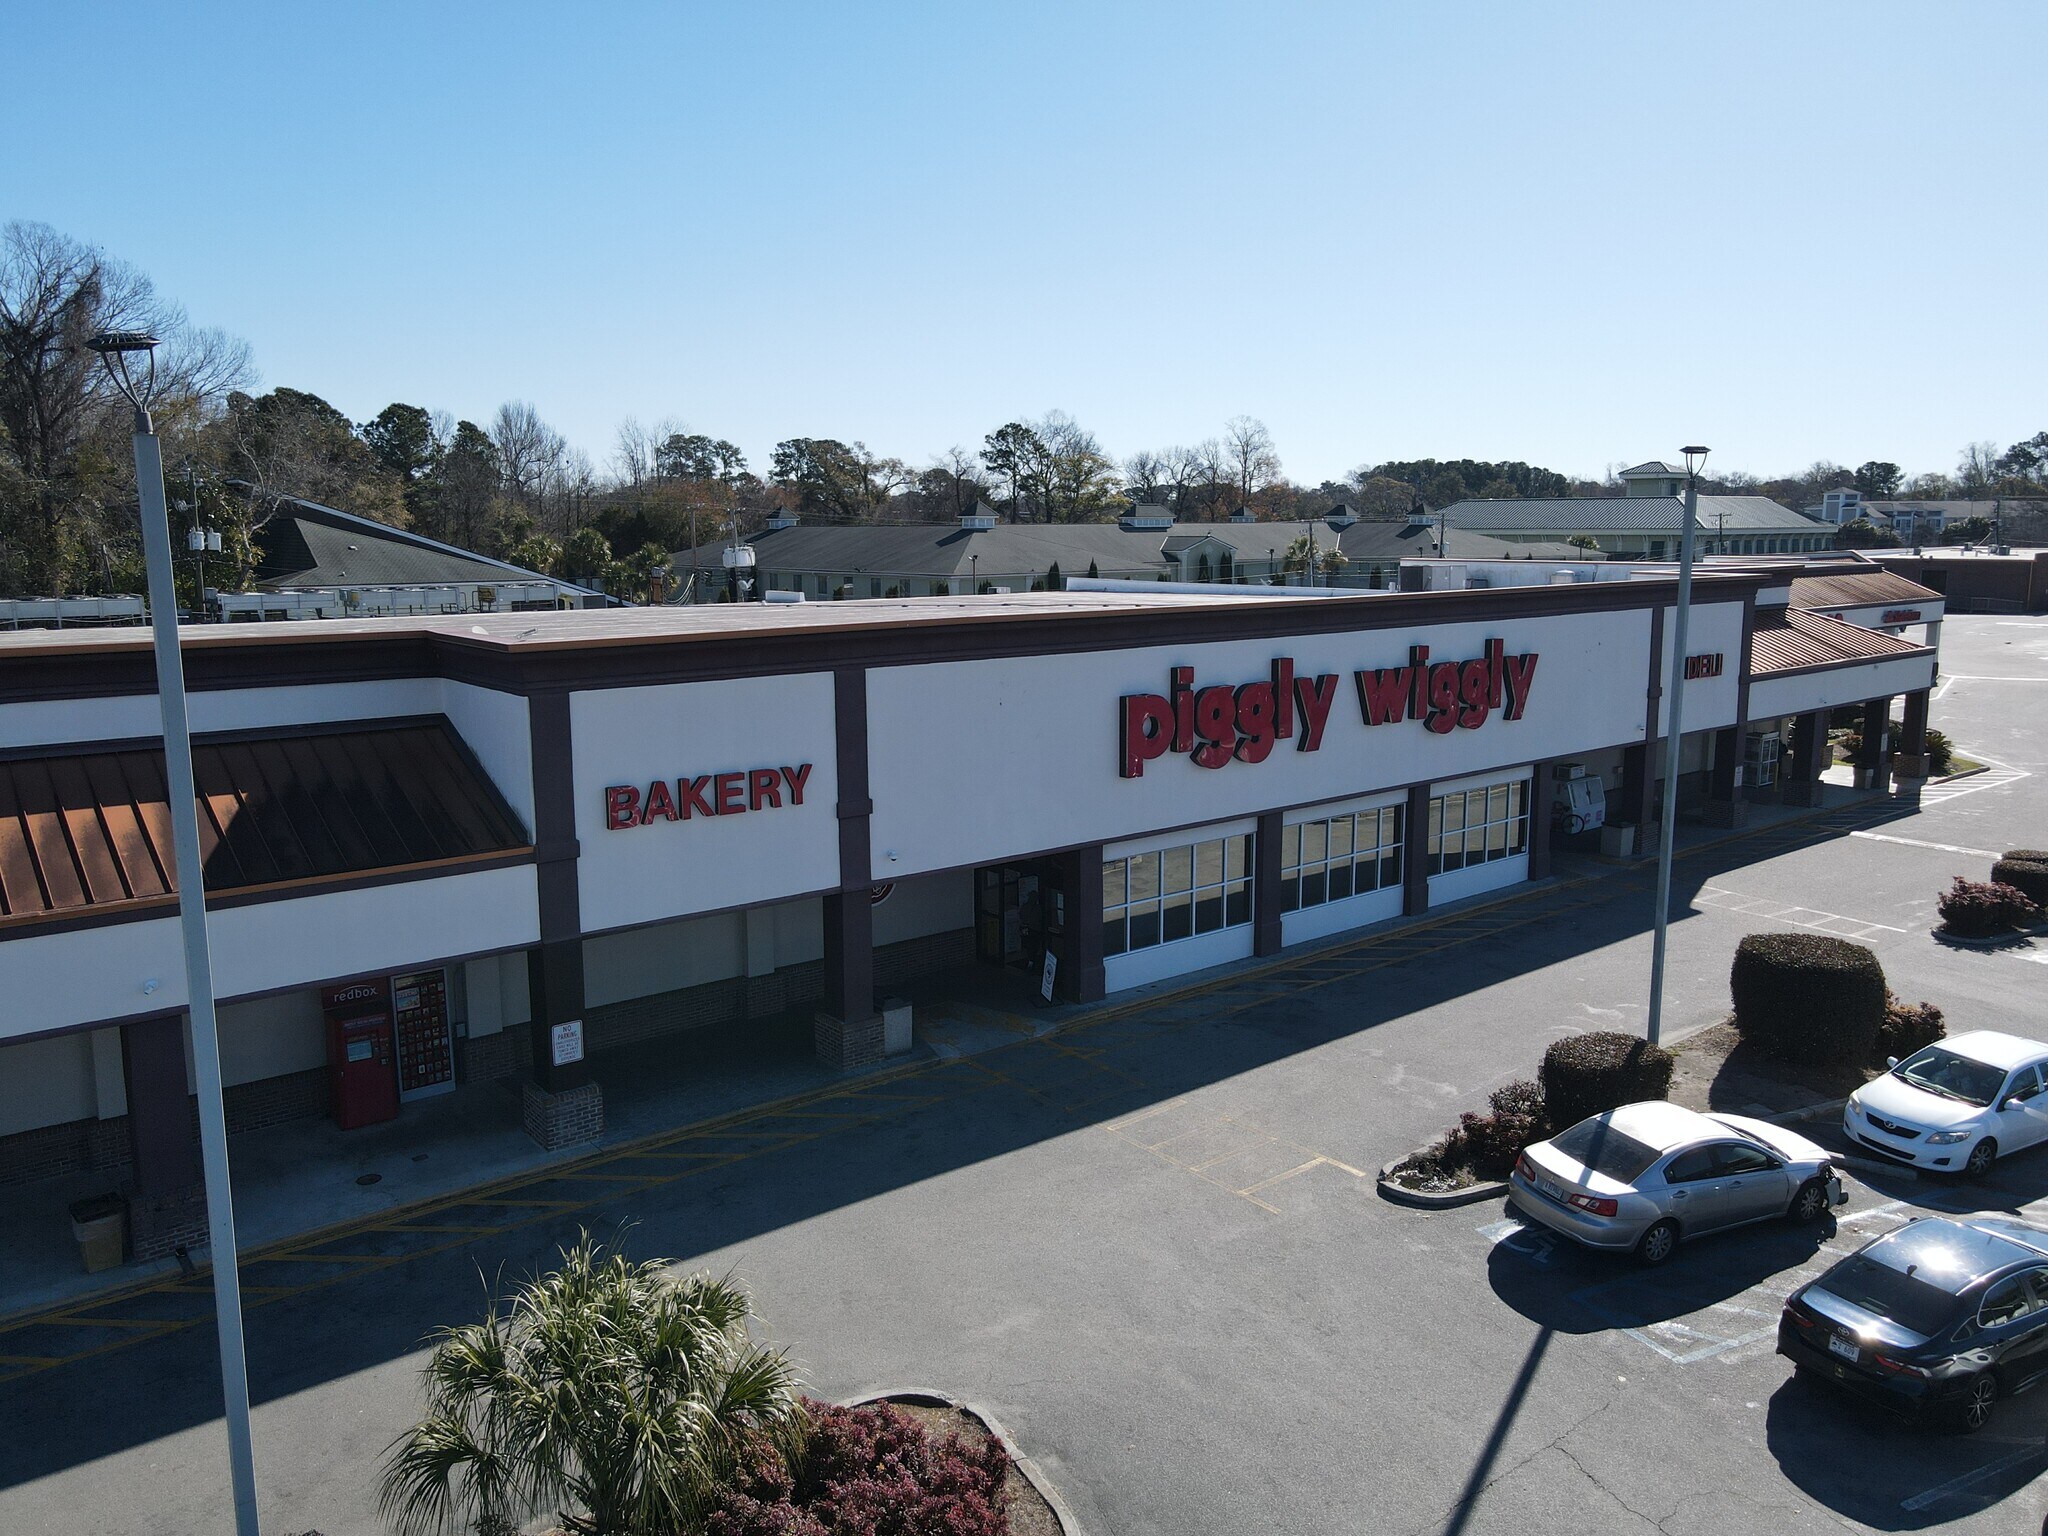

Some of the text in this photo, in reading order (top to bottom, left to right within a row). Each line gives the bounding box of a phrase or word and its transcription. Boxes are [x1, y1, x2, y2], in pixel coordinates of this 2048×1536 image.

[1684, 653, 1723, 680] DELI
[1119, 638, 1539, 778] piggly wiggly
[605, 763, 813, 830] BAKERY
[334, 986, 379, 1002] redbox
[557, 1030, 578, 1040] PARKING
